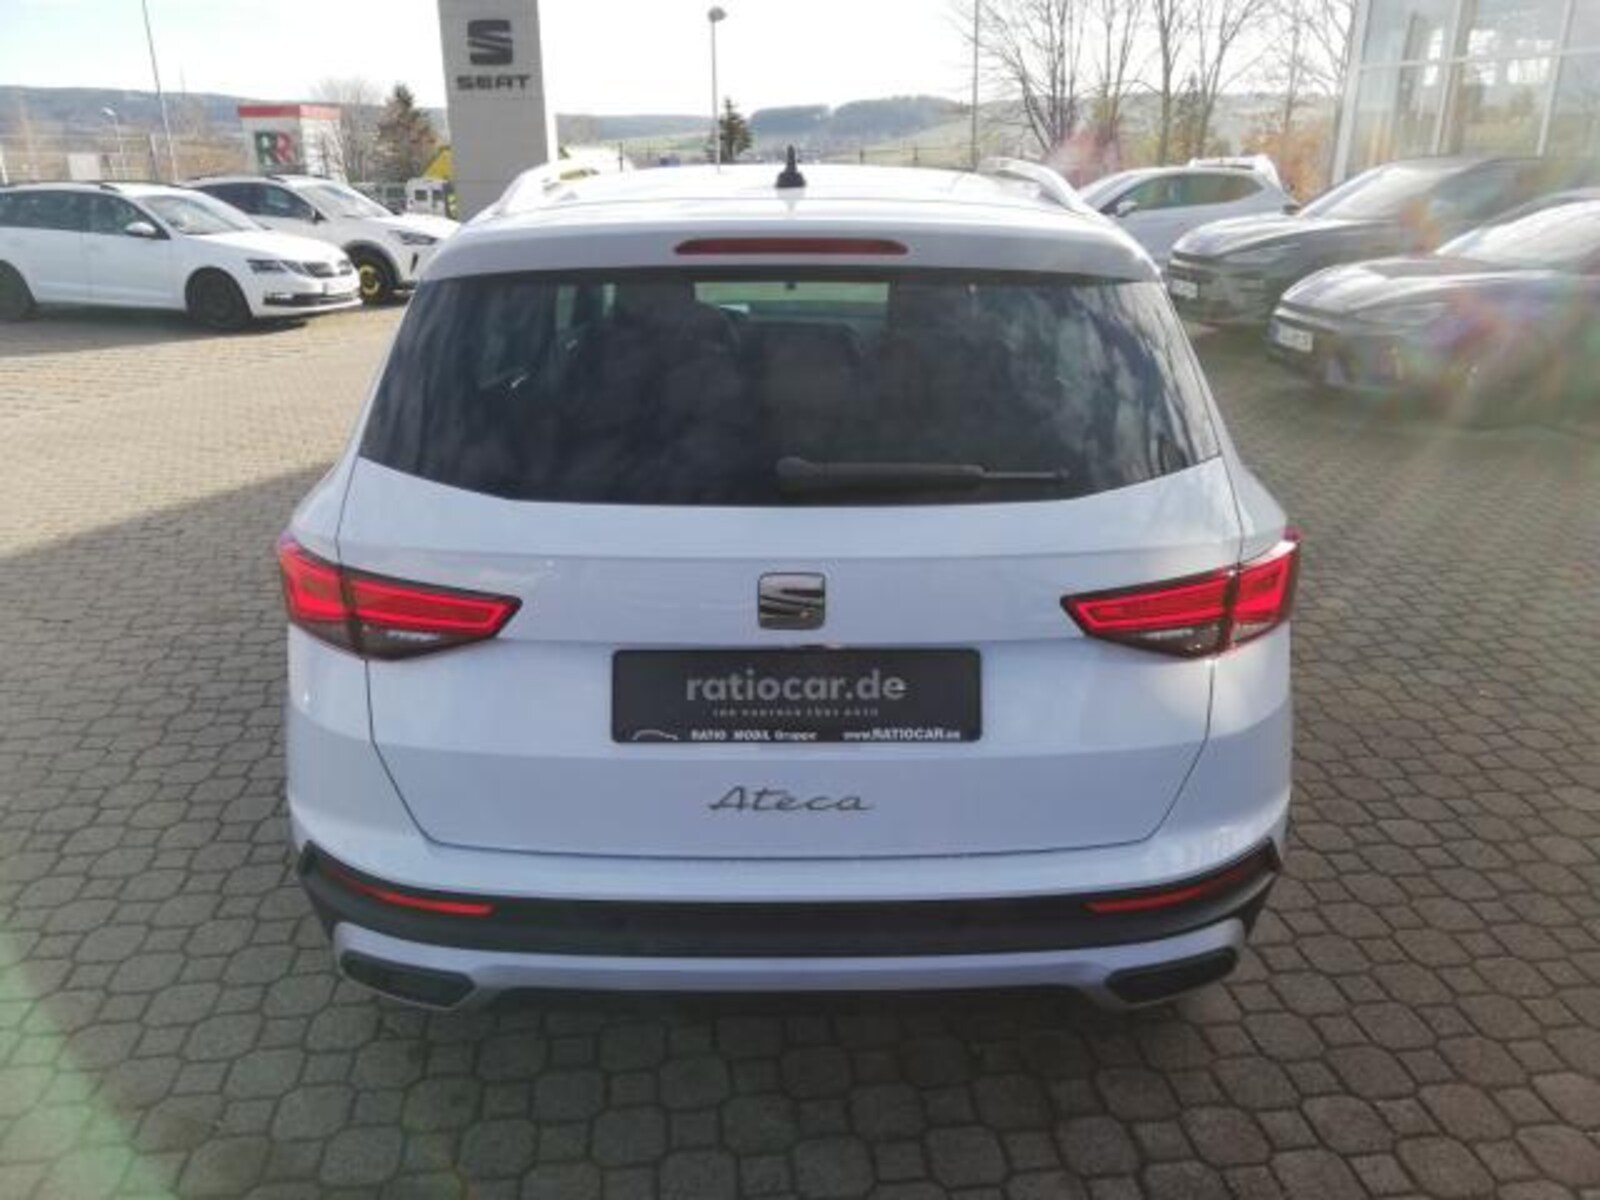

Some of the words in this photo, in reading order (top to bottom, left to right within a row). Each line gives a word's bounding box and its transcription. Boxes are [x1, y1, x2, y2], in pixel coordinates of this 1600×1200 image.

[457, 74, 530, 90] SEAT
[686, 668, 907, 702] ratiocar.de
[690, 729, 727, 741] RATIO
[708, 786, 872, 811] Ateca
